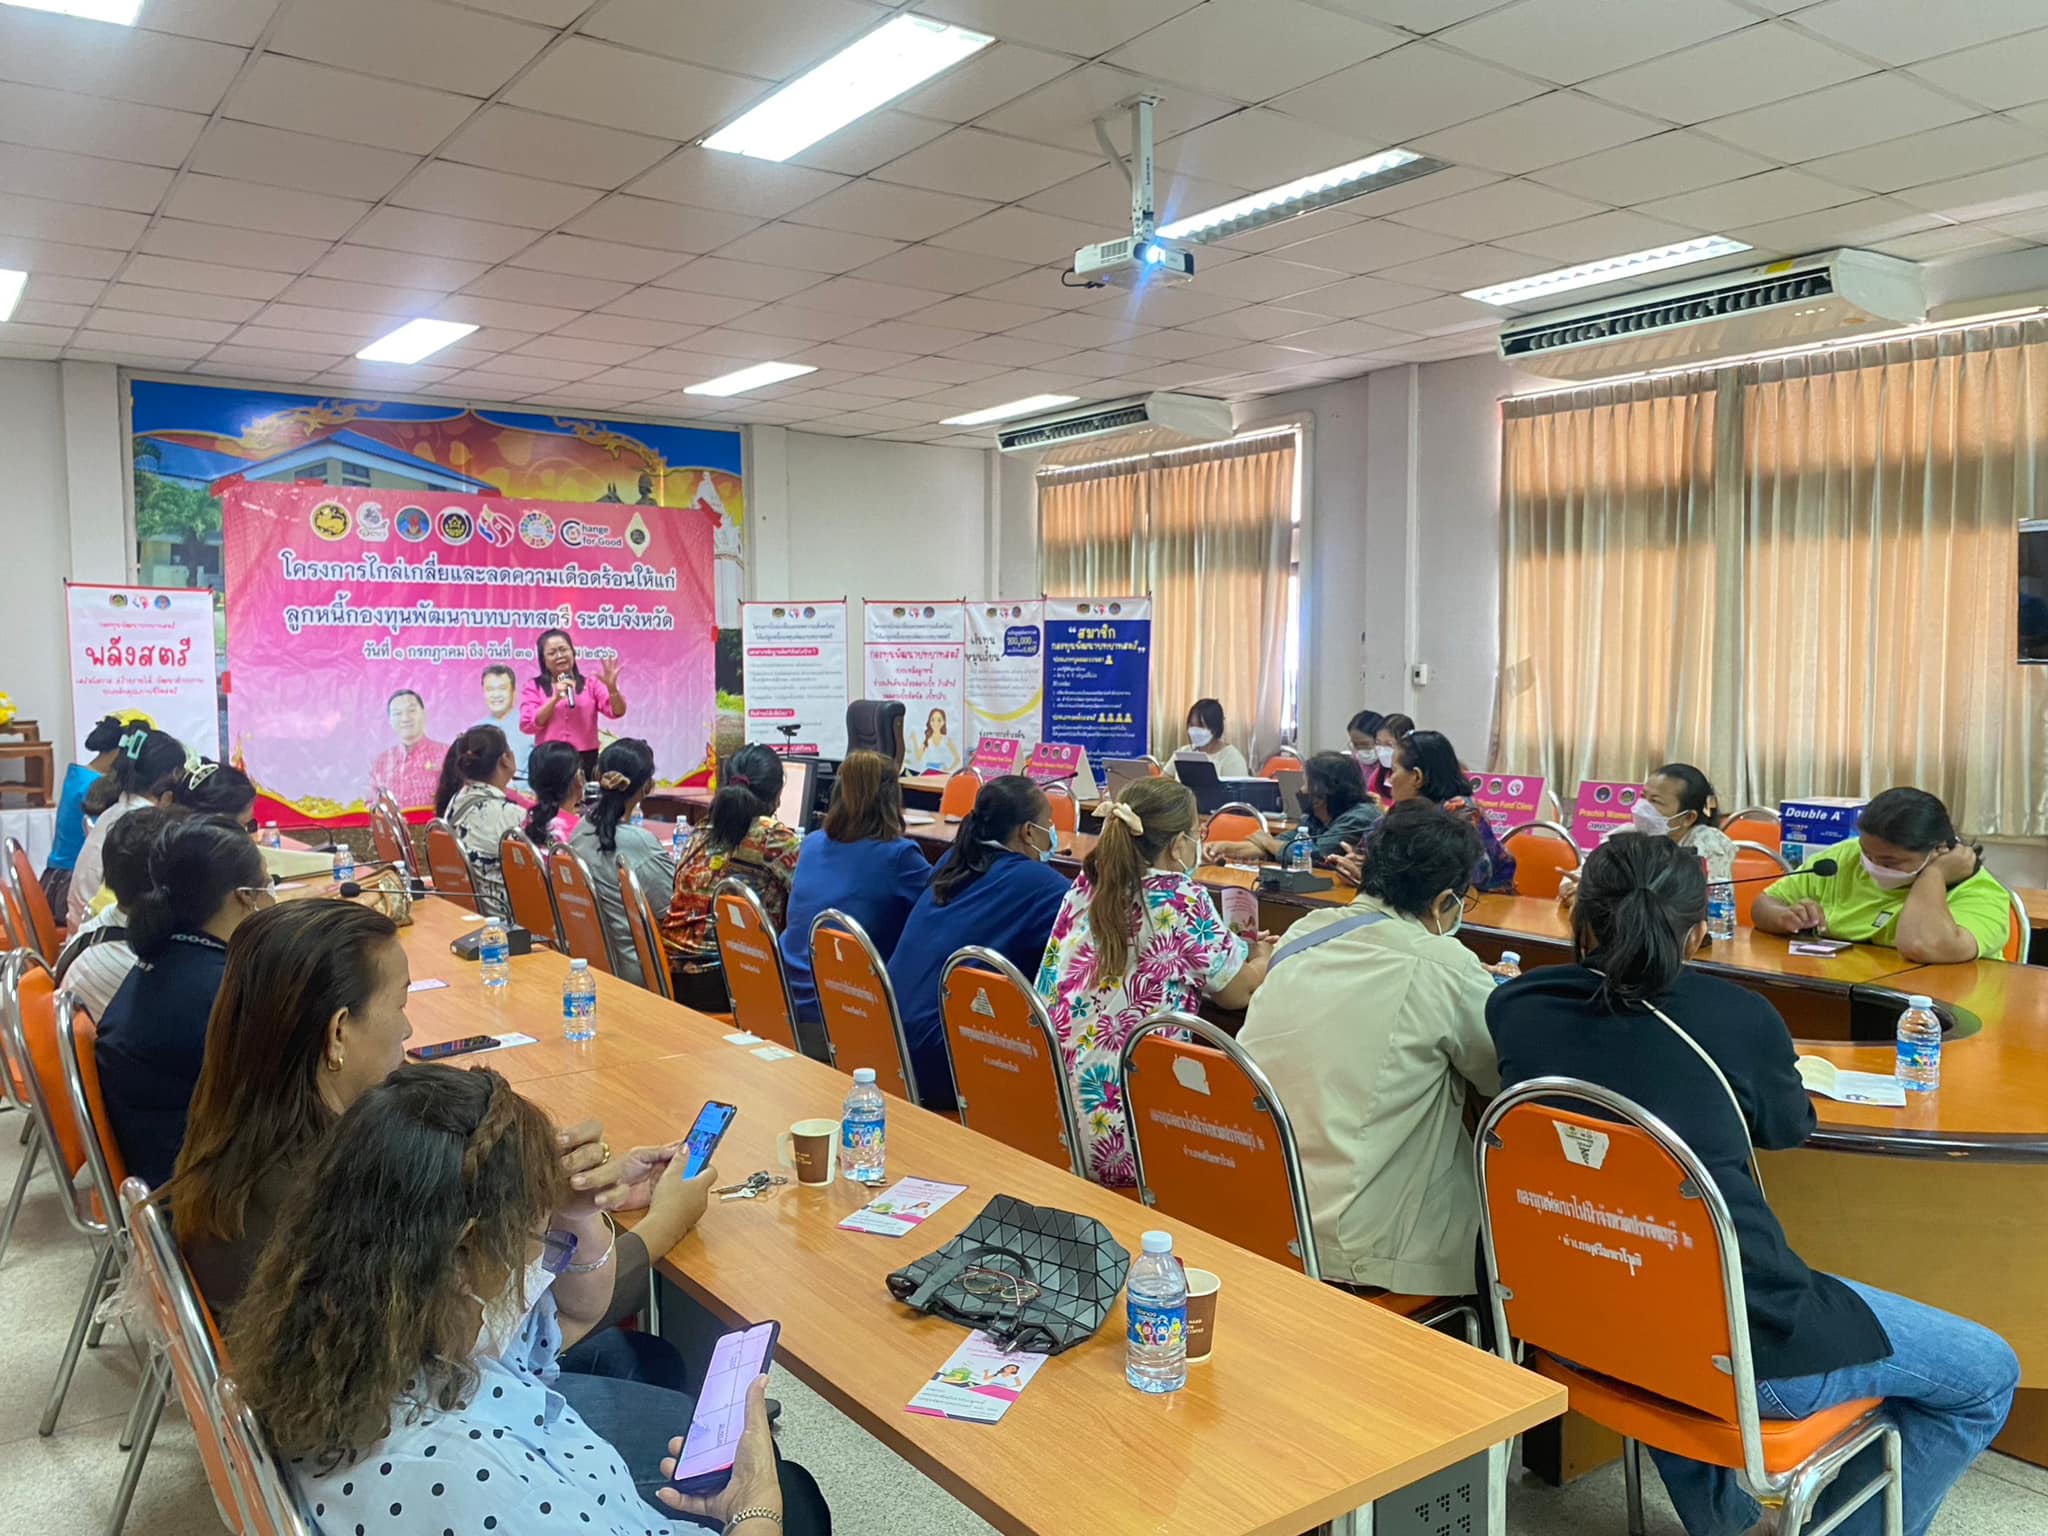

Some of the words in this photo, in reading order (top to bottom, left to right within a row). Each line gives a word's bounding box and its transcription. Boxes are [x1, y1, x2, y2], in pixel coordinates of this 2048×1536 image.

[561, 519, 609, 546] Change
[582, 537, 596, 546] for
[598, 537, 622, 547] Good
[280, 550, 676, 589] โครงการไกล่เกลี่ยและลดความเดือดร้อนให้แก่
[285, 593, 571, 632] ลูกหนี้กองทุนพัฒนาบทบาทสตรี
[577, 605, 673, 628] ระดับจังหวัด
[85, 636, 191, 667] พลังสตรี
[364, 640, 390, 658] วันที่
[409, 645, 465, 663] กรกฎาคม
[470, 643, 484, 658] ถึง
[488, 640, 512, 659] วันที่
[1785, 807, 1827, 821] Double
[1831, 811, 1841, 821] A
